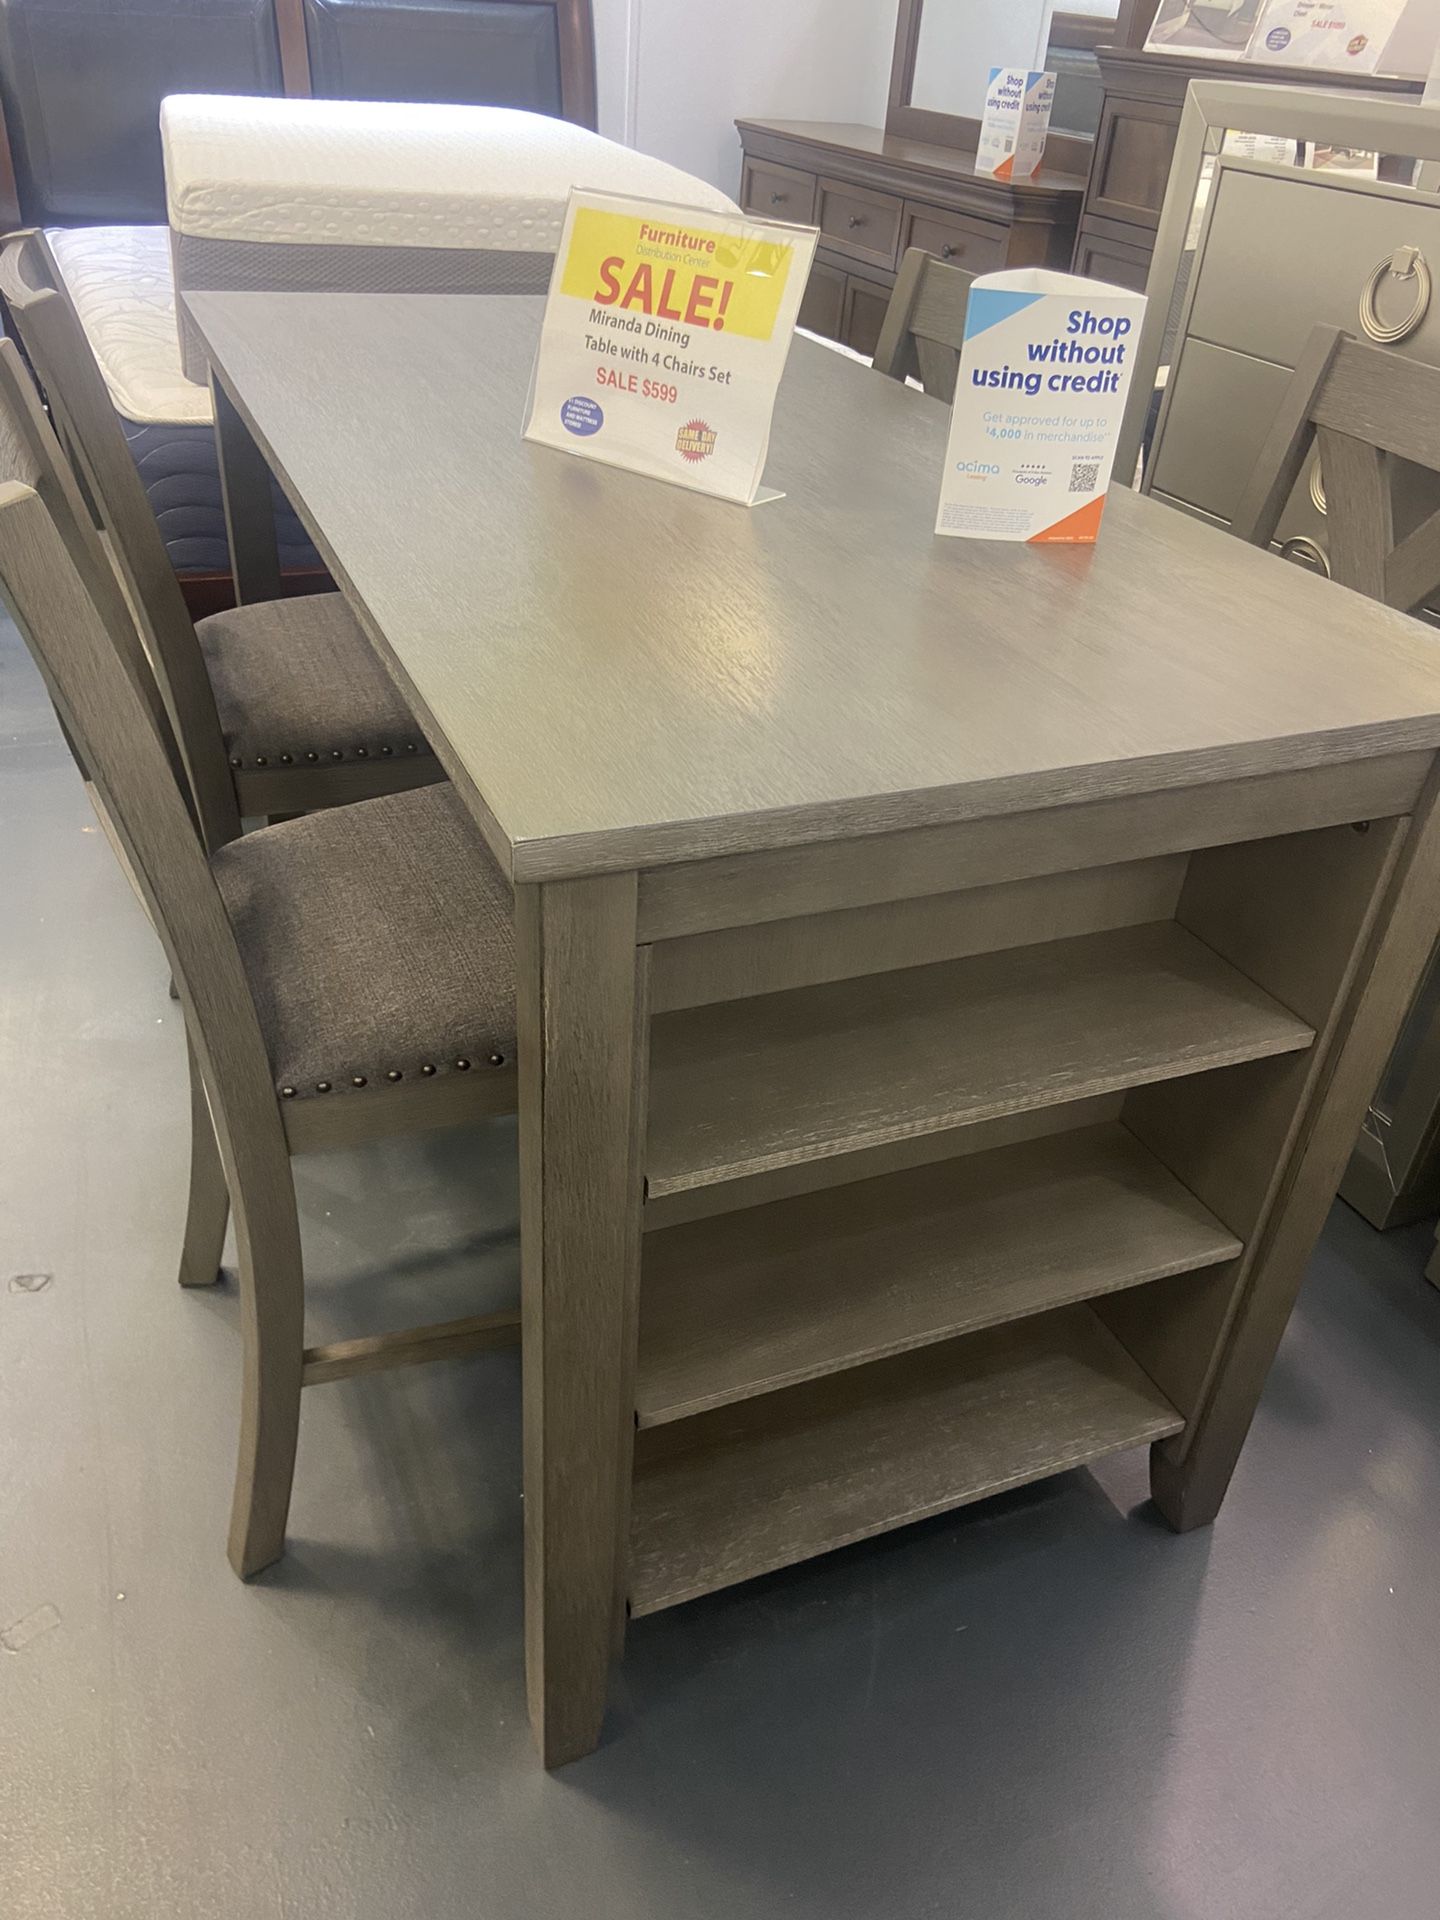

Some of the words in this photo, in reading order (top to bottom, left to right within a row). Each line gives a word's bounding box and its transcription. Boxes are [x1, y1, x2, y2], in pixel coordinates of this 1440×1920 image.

[998, 87, 1022, 98] without
[1007, 75, 1023, 87] Shop
[987, 98, 1001, 110] using
[1001, 100, 1020, 111] credit
[639, 223, 716, 254] Furniture
[636, 244, 682, 264] Distribution
[683, 253, 711, 270] Center
[594, 255, 734, 332] SALE!
[589, 308, 642, 335] Miranda
[644, 321, 690, 349] Dining
[1067, 310, 1131, 340] Shop
[584, 334, 617, 357] Table
[620, 343, 649, 367] with
[651, 352, 660, 368] 4
[663, 354, 705, 379] Chairs
[708, 366, 732, 385] Set
[1027, 339, 1126, 365] without
[596, 366, 638, 393] SALE
[641, 377, 678, 404] $599
[972, 365, 1042, 396] using
[983, 411, 1003, 423] Get
[1006, 414, 1060, 427] approved
[1062, 415, 1078, 427] for
[1079, 418, 1094, 429] up
[1096, 417, 1108, 428] to
[679, 428, 697, 442] SAME
[700, 430, 716, 444] DAY
[985, 426, 1022, 440] $4,000
[1023, 429, 1034, 441] in
[956, 460, 1000, 475] acima
[1015, 474, 1048, 487] Google
